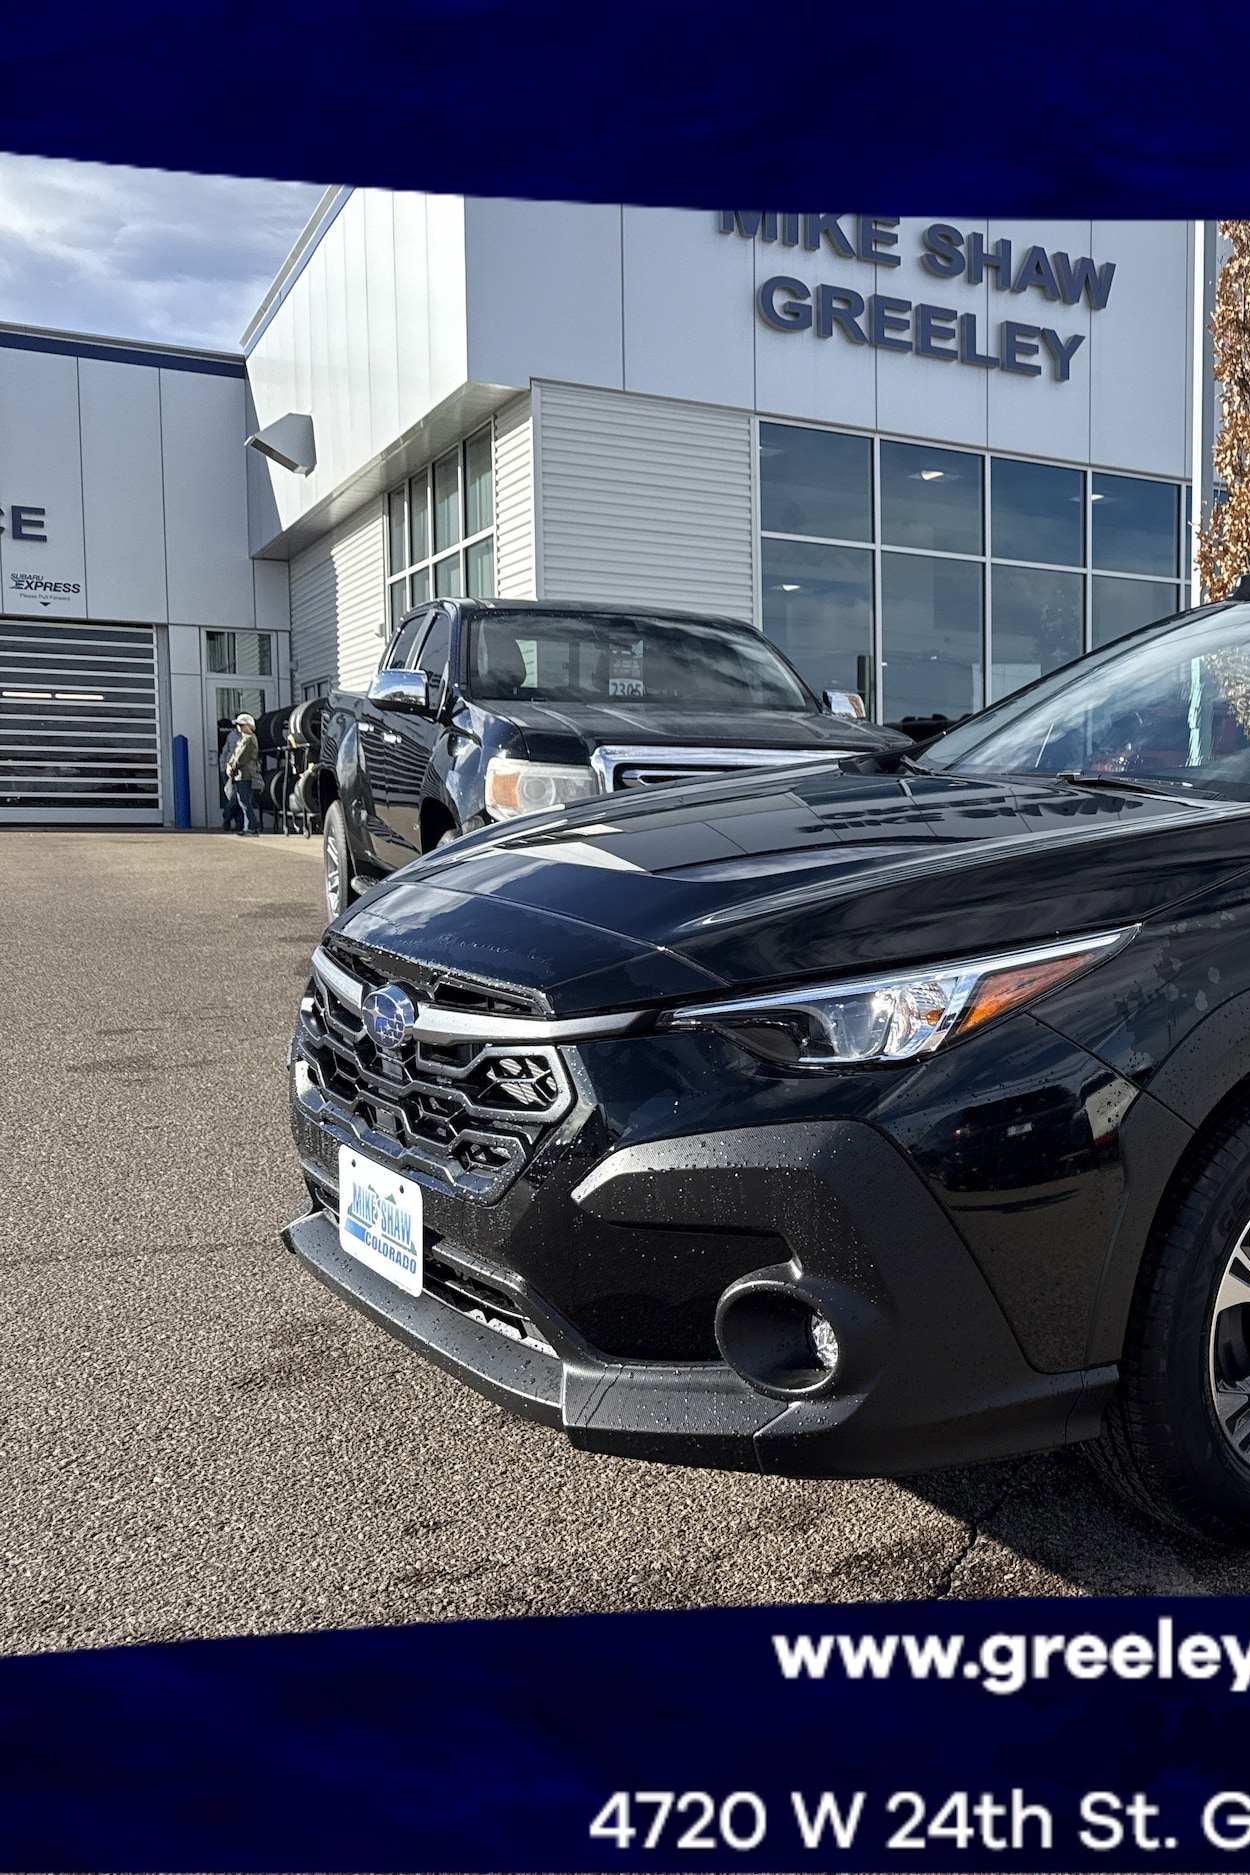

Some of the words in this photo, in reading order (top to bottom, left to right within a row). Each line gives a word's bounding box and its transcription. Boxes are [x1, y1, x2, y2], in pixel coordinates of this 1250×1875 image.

[919, 223, 1117, 311] SHAW
[757, 275, 1086, 382] GREELEY
[10, 572, 44, 581] SUBARU
[11, 580, 81, 594] EXPRESS
[352, 1181, 378, 1225] MIKE
[380, 1199, 412, 1246] SHAW
[364, 1230, 418, 1275] COLORADO
